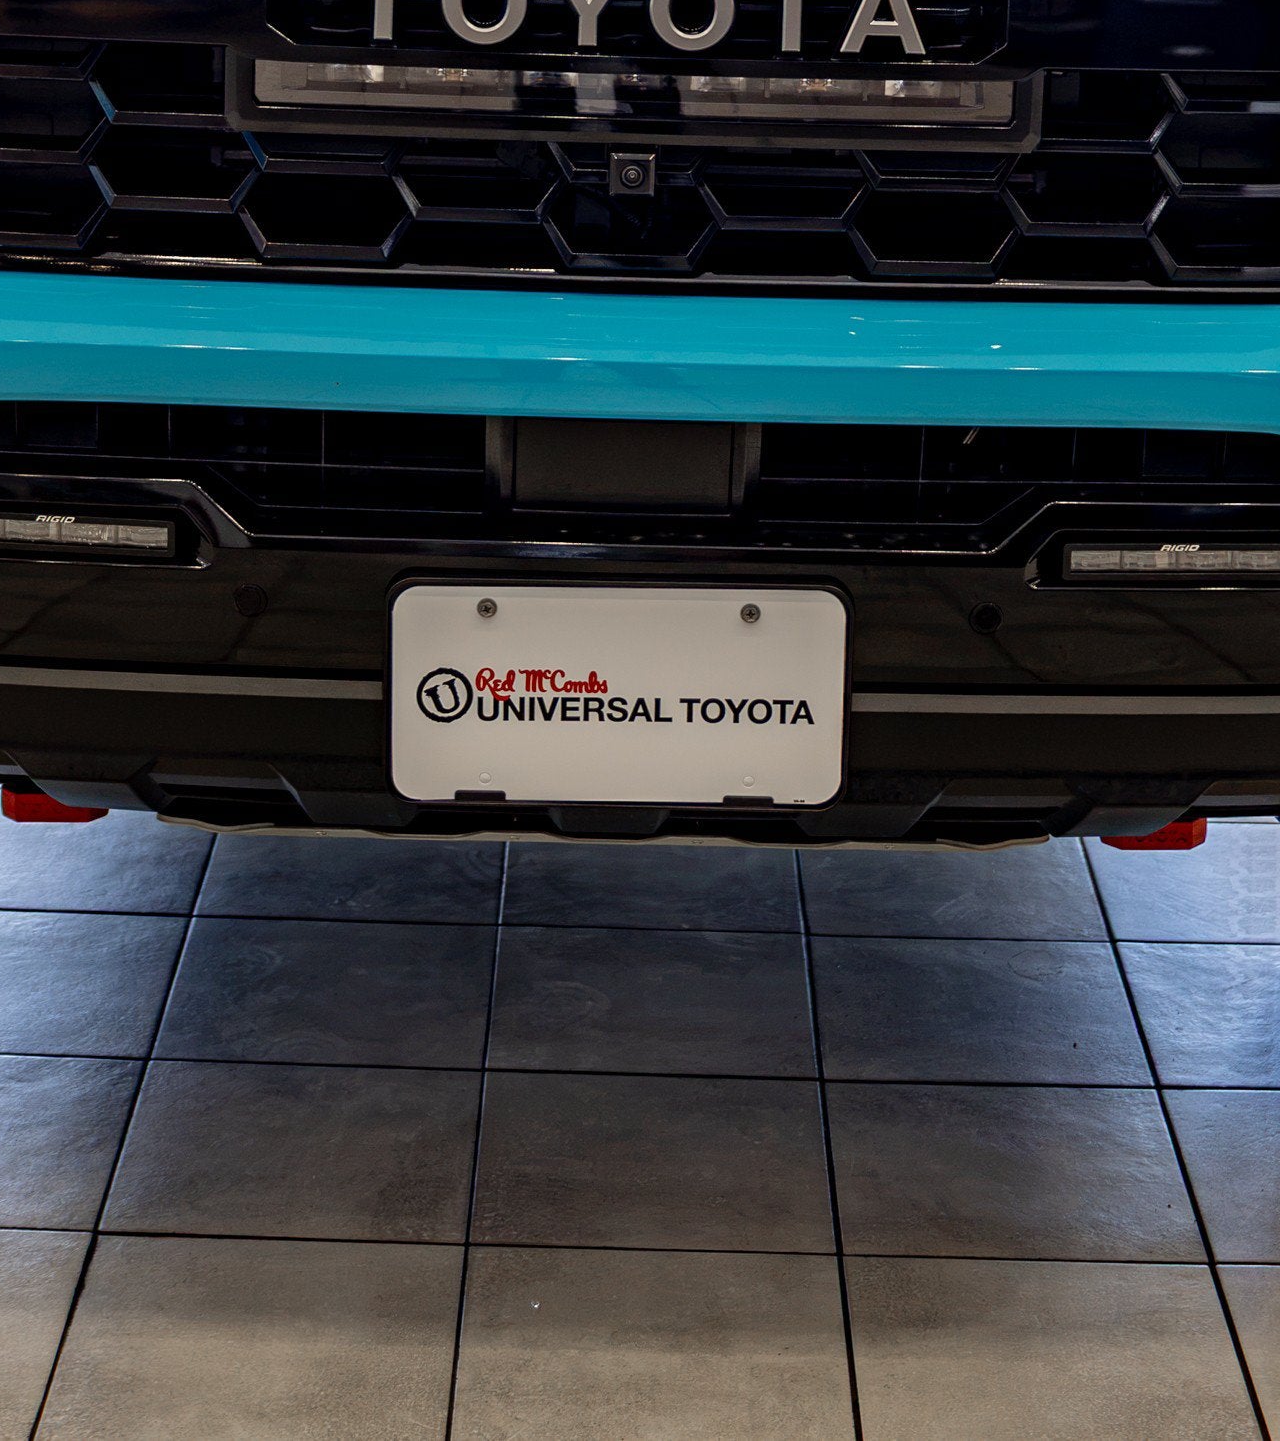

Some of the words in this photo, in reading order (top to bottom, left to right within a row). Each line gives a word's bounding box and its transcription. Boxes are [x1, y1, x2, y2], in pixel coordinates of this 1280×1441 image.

[36, 515, 75, 523] RIGID
[475, 667, 516, 701] Red
[518, 668, 608, 694] McCombs
[476, 696, 673, 723] UNIVERSAL
[679, 697, 816, 725] TOYOTA
